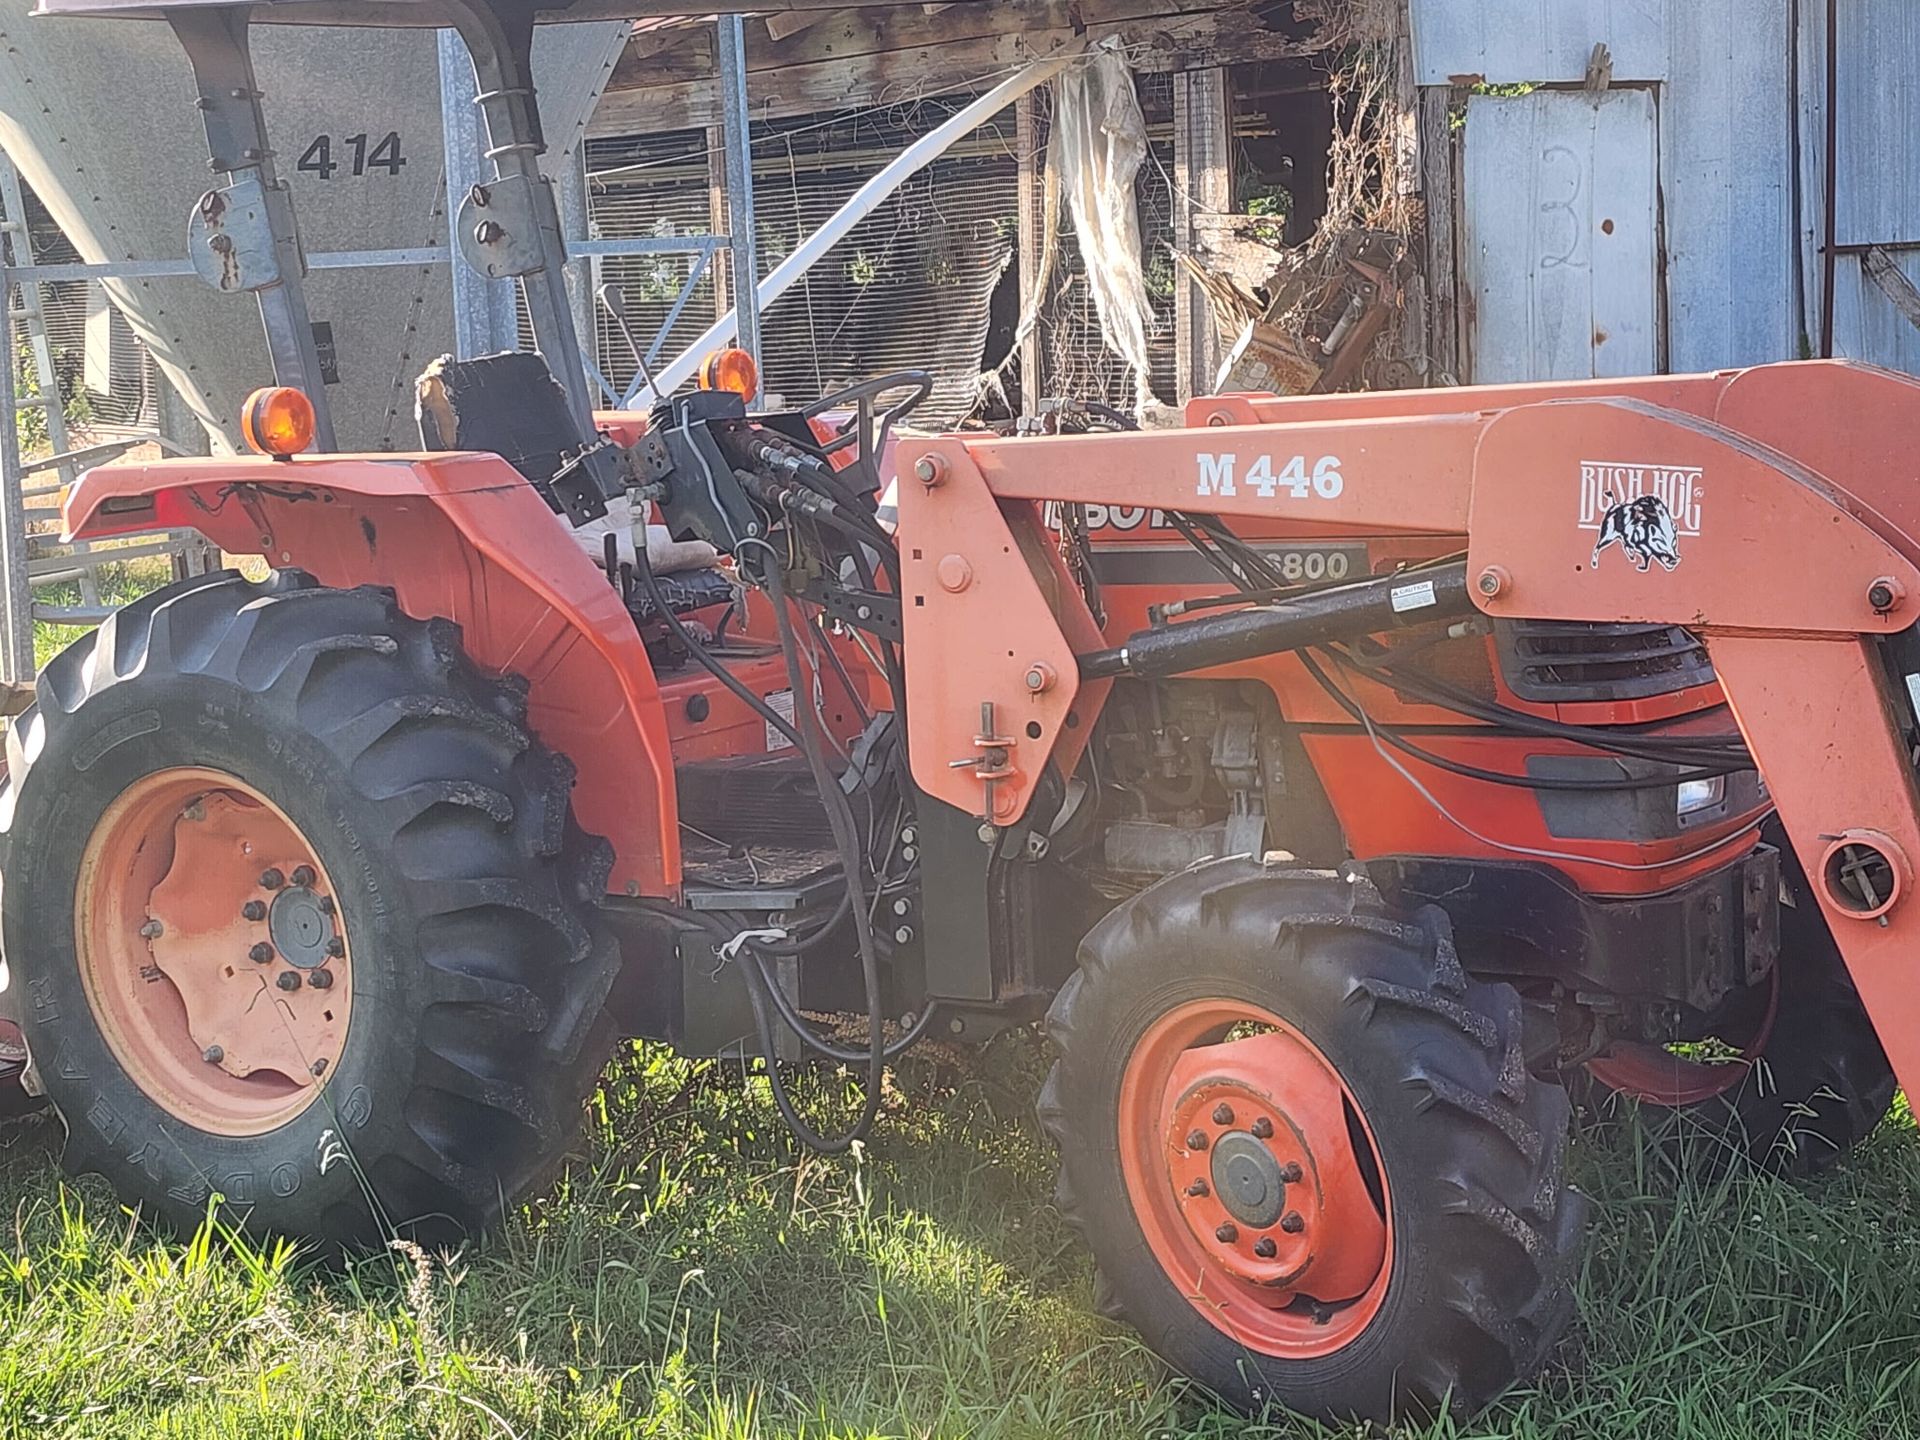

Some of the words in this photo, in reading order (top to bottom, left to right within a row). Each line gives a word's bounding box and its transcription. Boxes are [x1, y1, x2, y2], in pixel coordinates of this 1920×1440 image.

[298, 131, 407, 180] 414
[1197, 453, 1237, 497] M
[1245, 454, 1344, 499] 446
[1579, 466, 1644, 523] BUSH
[1652, 470, 1703, 531] HOG
[1399, 583, 1430, 595] CAUTION
